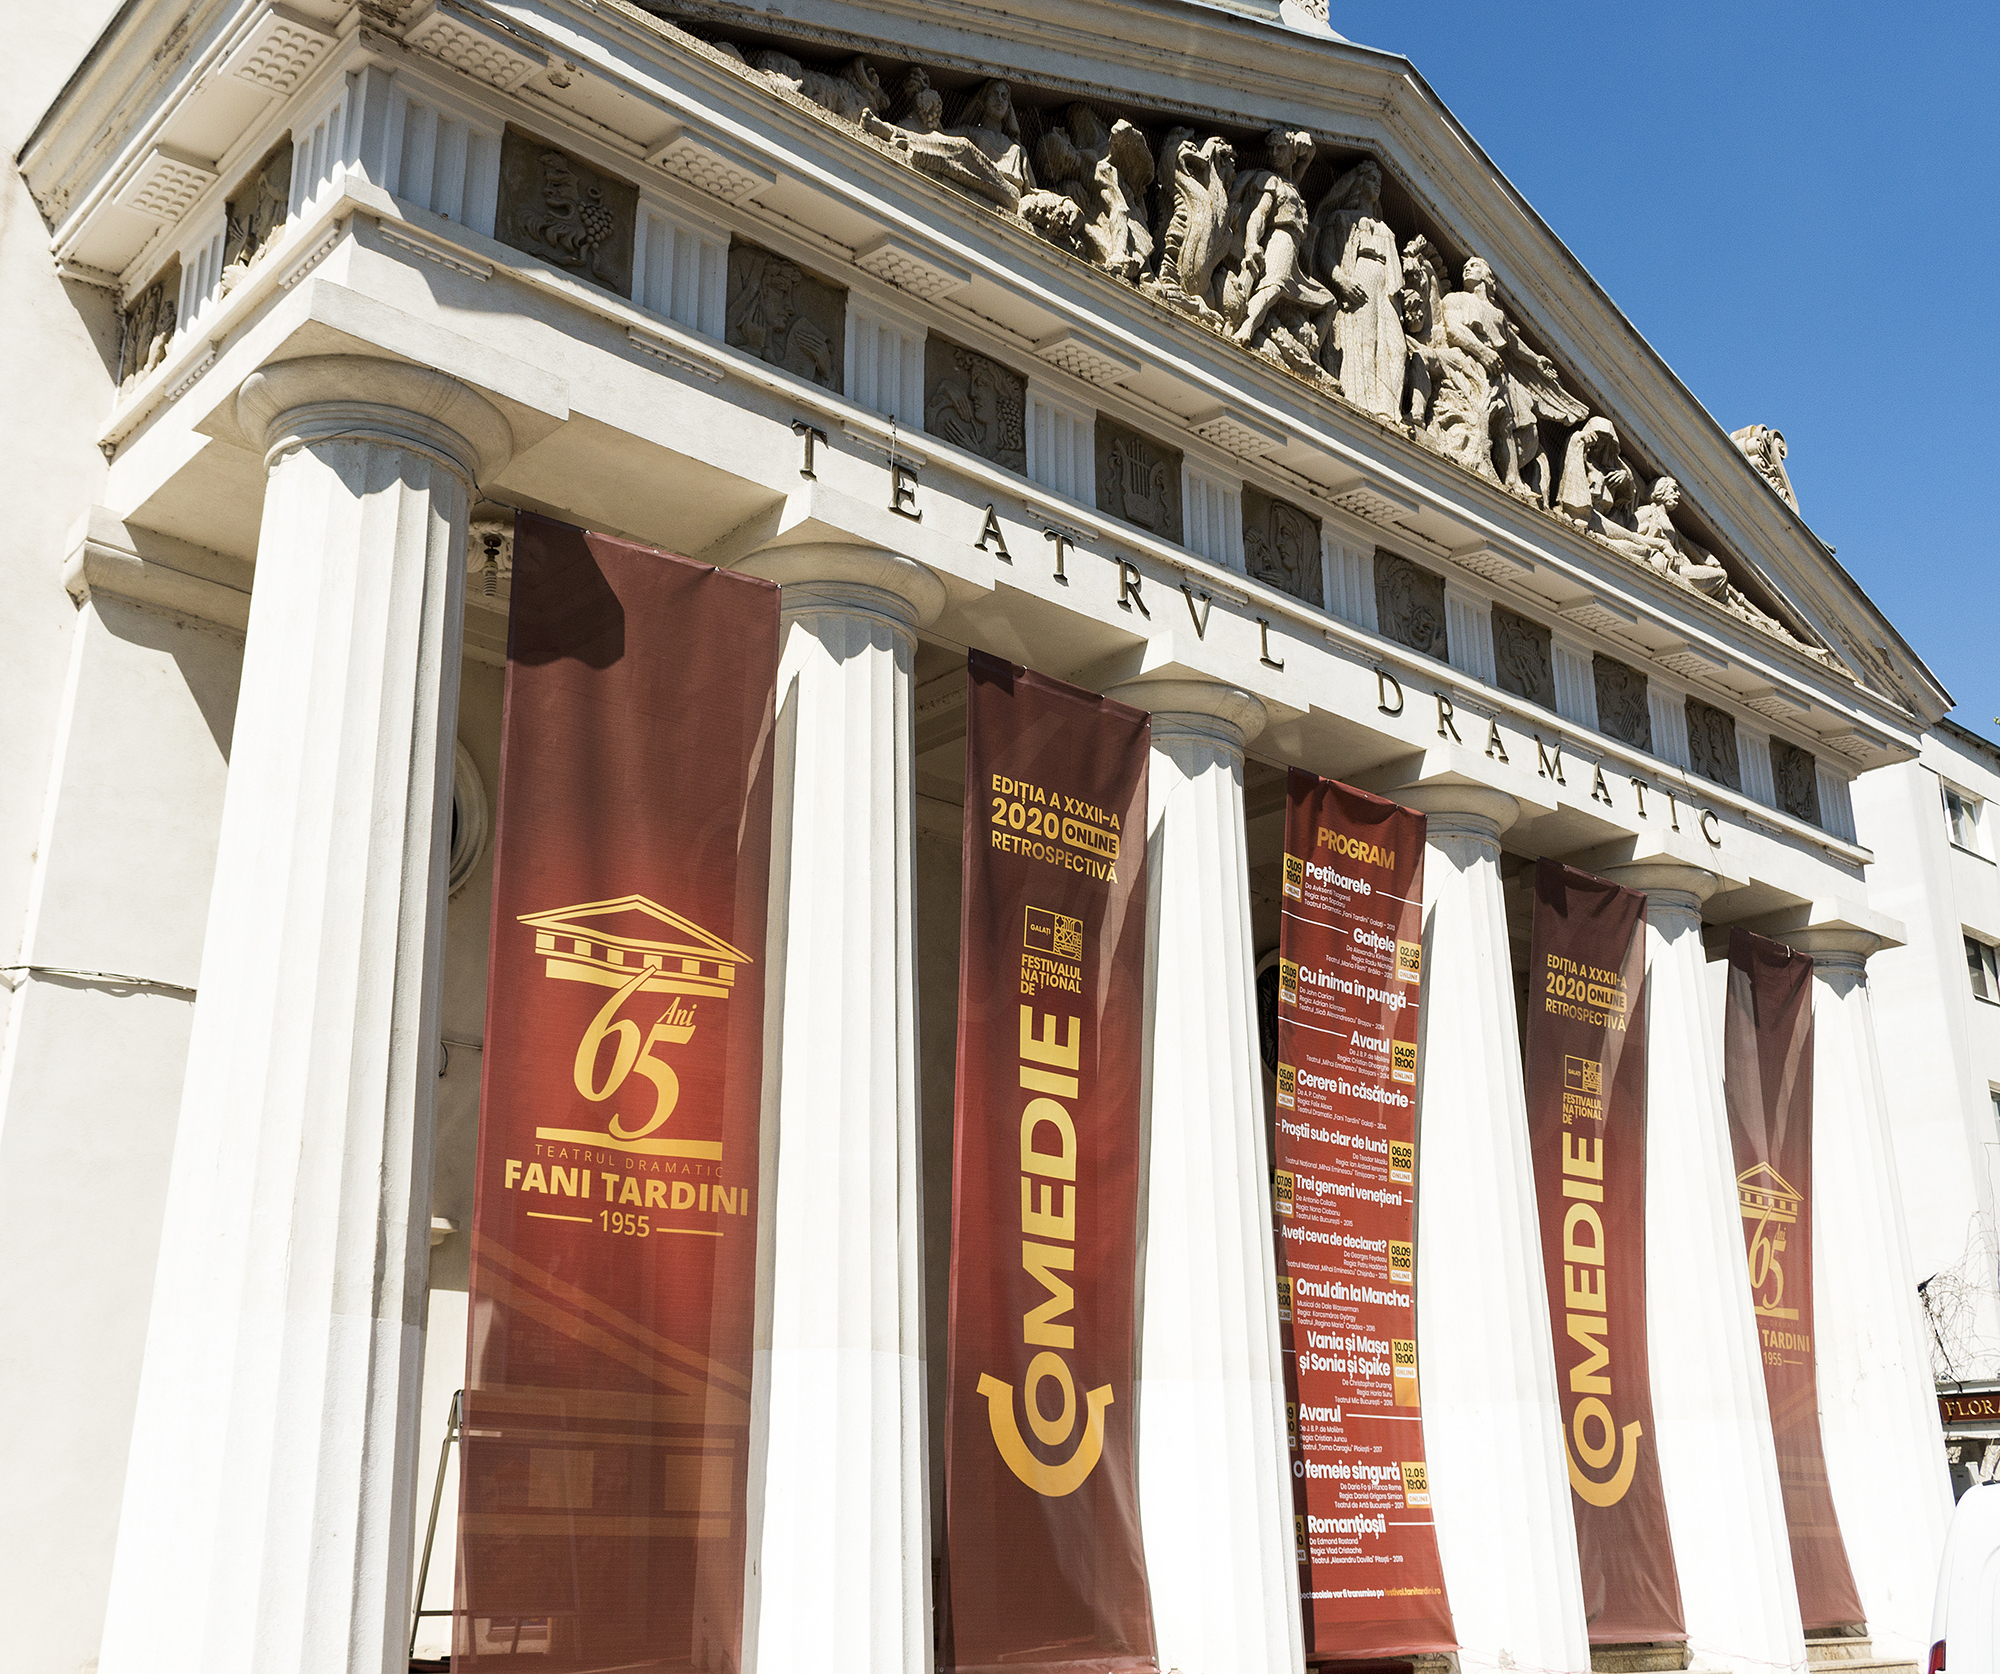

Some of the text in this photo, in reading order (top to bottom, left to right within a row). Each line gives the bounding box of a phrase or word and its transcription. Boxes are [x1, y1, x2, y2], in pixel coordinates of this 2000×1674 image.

[791, 419, 1721, 848] TEATRVL DRAMATIC
[992, 773, 1120, 830] EDIȚIA A XXXII-A
[991, 797, 1117, 854] 2020 ONLINE
[992, 830, 1118, 884] RETROSPECTIVĂ
[1317, 827, 1395, 870] PROGRAM
[1306, 861, 1371, 895] Pețitoarele
[1030, 923, 1051, 936] GALAȚI
[1353, 928, 1395, 953] Gaițele
[1400, 946, 1420, 959] 02.09
[1400, 957, 1419, 969] 19:00
[1021, 953, 1082, 981] FESTIVALUL
[1399, 970, 1419, 981] ONLINE
[1547, 954, 1627, 989] EDIȚIA A XXXII-A
[1020, 980, 1035, 997] DE
[1021, 967, 1081, 994] NAȚIONAL
[1299, 966, 1316, 984] Cu
[1318, 969, 1353, 994] inima
[1354, 980, 1366, 998] în
[1367, 990, 1406, 1011] pungă
[1546, 972, 1624, 1009] 2020 ONLINE
[657, 996, 697, 1026] Ani
[1546, 998, 1626, 1032] RETROSPECTIVĂ
[574, 965, 696, 1139] 65
[1351, 1030, 1390, 1054] Avarul
[1394, 1046, 1415, 1058] 04.09
[1394, 1057, 1414, 1069] 19:00
[1279, 1080, 1294, 1093] 19:00
[1393, 1071, 1414, 1082] ONLINE
[1297, 1069, 1337, 1093] Cerere
[1338, 1077, 1351, 1096] în
[1352, 1082, 1408, 1108] căsătorie
[1563, 1092, 1602, 1110] FESTIVALUL
[1563, 1103, 1602, 1121] NAȚIONAL
[1562, 1114, 1573, 1125] DE
[1310, 1128, 1330, 1143] sub
[1331, 1130, 1351, 1146] clar
[1351, 1134, 1364, 1149] de
[1365, 1136, 1388, 1154] lună
[1392, 1146, 1411, 1157] 06.09
[535, 1144, 724, 1178] TEATRUL DRAMATIC
[1392, 1157, 1411, 1169] 19:00
[505, 1158, 748, 1216] FANI TARDINI
[1276, 1175, 1292, 1188] 07.09
[1391, 1172, 1410, 1180] ONLINE
[1276, 1186, 1292, 1199] 19:00
[1295, 1174, 1402, 1207] Trei gemeni venețieni
[1276, 1202, 1291, 1212] ONLINE
[600, 1209, 650, 1238] 1955
[976, 1004, 1114, 1497] COMEDIE
[1281, 1225, 1387, 1253] Aveți ceva de declarat?
[1391, 1245, 1411, 1257] 08.09
[1392, 1256, 1411, 1268] 19:00
[1749, 1204, 1787, 1309] 65
[1391, 1271, 1410, 1280] ONLINE
[1297, 1278, 1410, 1308] Omul din la Mancha
[1562, 1132, 1643, 1507] COMEDIE
[1307, 1330, 1389, 1360] Vania și Mașa
[1394, 1341, 1413, 1353] 10.09
[1762, 1330, 1810, 1352] TARDINI
[1300, 1350, 1391, 1380] și Sonia și Spike
[1394, 1353, 1414, 1365] 19:00
[1763, 1351, 1782, 1366] 1955
[1396, 1368, 1415, 1377] ONLINE
[1299, 1403, 1341, 1422] Avarul
[1945, 1400, 2000, 1415] FLOR
[1293, 1459, 1400, 1485] O femeie singură
[1404, 1467, 1425, 1478] 12.09
[1406, 1479, 1427, 1490] 19:00
[1408, 1495, 1428, 1503] ONLINE
[1307, 1513, 1386, 1539] Romanțioșii
